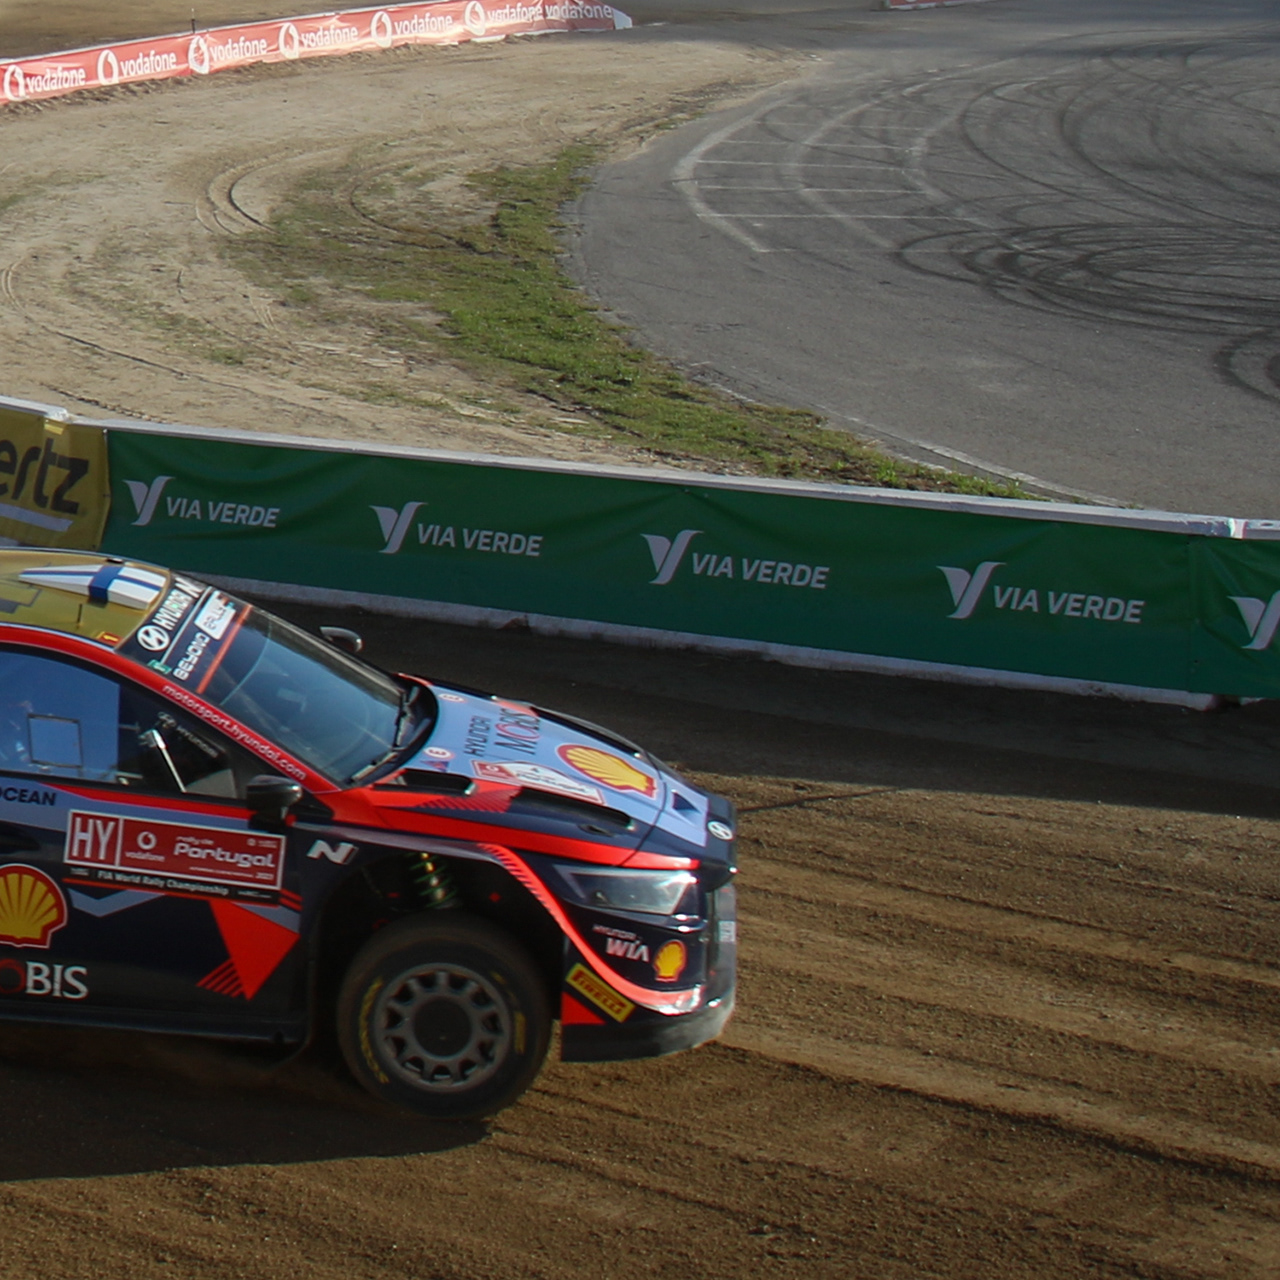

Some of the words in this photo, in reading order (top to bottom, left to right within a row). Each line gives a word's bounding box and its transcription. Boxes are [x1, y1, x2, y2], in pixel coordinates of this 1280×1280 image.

[394, 13, 453, 36] vodafone
[487, 2, 542, 23] vodafone
[544, 0, 613, 20] vodafone
[209, 35, 268, 62] vodafone
[301, 26, 358, 49] vodafone
[120, 50, 177, 77] vodafone
[26, 66, 86, 93] vodafone
[166, 496, 202, 520] VIA
[207, 501, 280, 528] VERDE
[417, 523, 456, 549] VIA
[461, 528, 543, 557] VERDE
[692, 552, 734, 579] VIA
[740, 558, 830, 589] VERDE
[152, 588, 192, 631] HYUNDAI
[993, 585, 1040, 612] VIA
[1047, 591, 1145, 624] VERDE
[173, 632, 210, 681] BEYOND
[162, 684, 307, 781] motorsport.hyundai.com
[463, 715, 491, 758] HYUNDAI
[71, 817, 115, 860] HY
[125, 851, 165, 863] vodafone
[174, 841, 276, 868] Portugal
[97, 870, 113, 882] FIA
[114, 872, 140, 884] World
[142, 875, 166, 889] Rally
[166, 878, 230, 897] Championship
[606, 937, 650, 963] WIA
[570, 968, 628, 1016] PIRELLI
